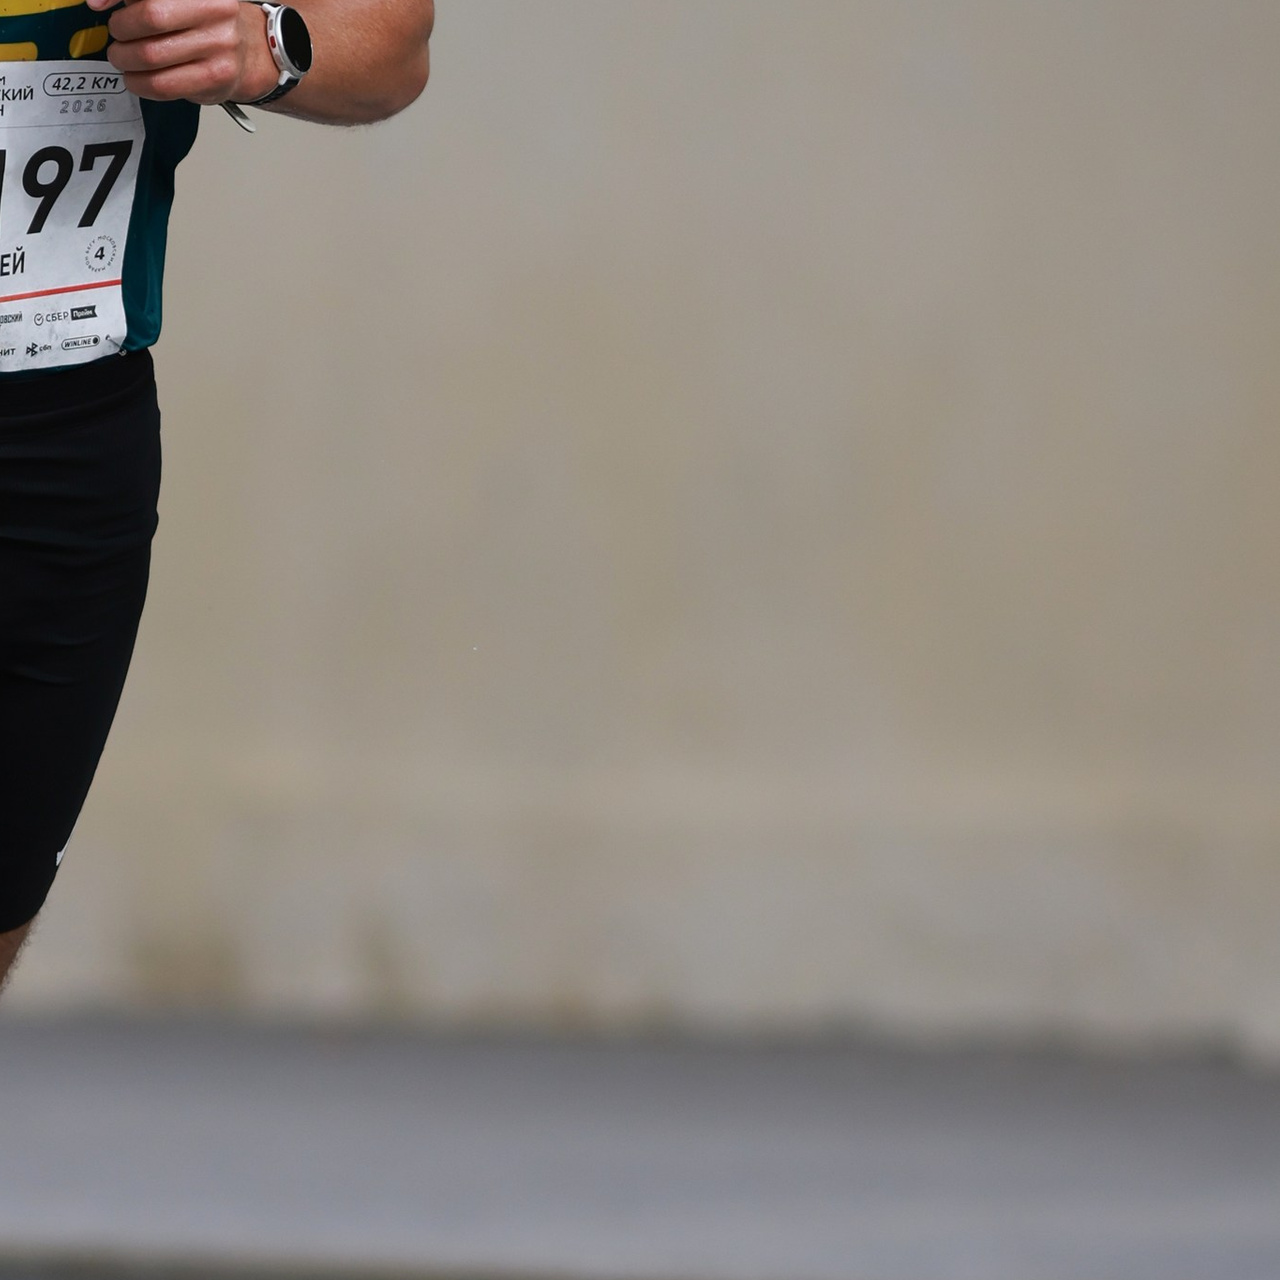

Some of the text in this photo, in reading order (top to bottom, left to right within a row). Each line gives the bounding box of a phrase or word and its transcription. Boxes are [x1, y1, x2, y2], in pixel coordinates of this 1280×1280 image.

[52, 76, 119, 92] 42,2 КМ
[59, 98, 107, 114] 2026
[94, 246, 105, 260] 4
[45, 311, 69, 323] СБЕР
[63, 338, 92, 349] WINLINE
